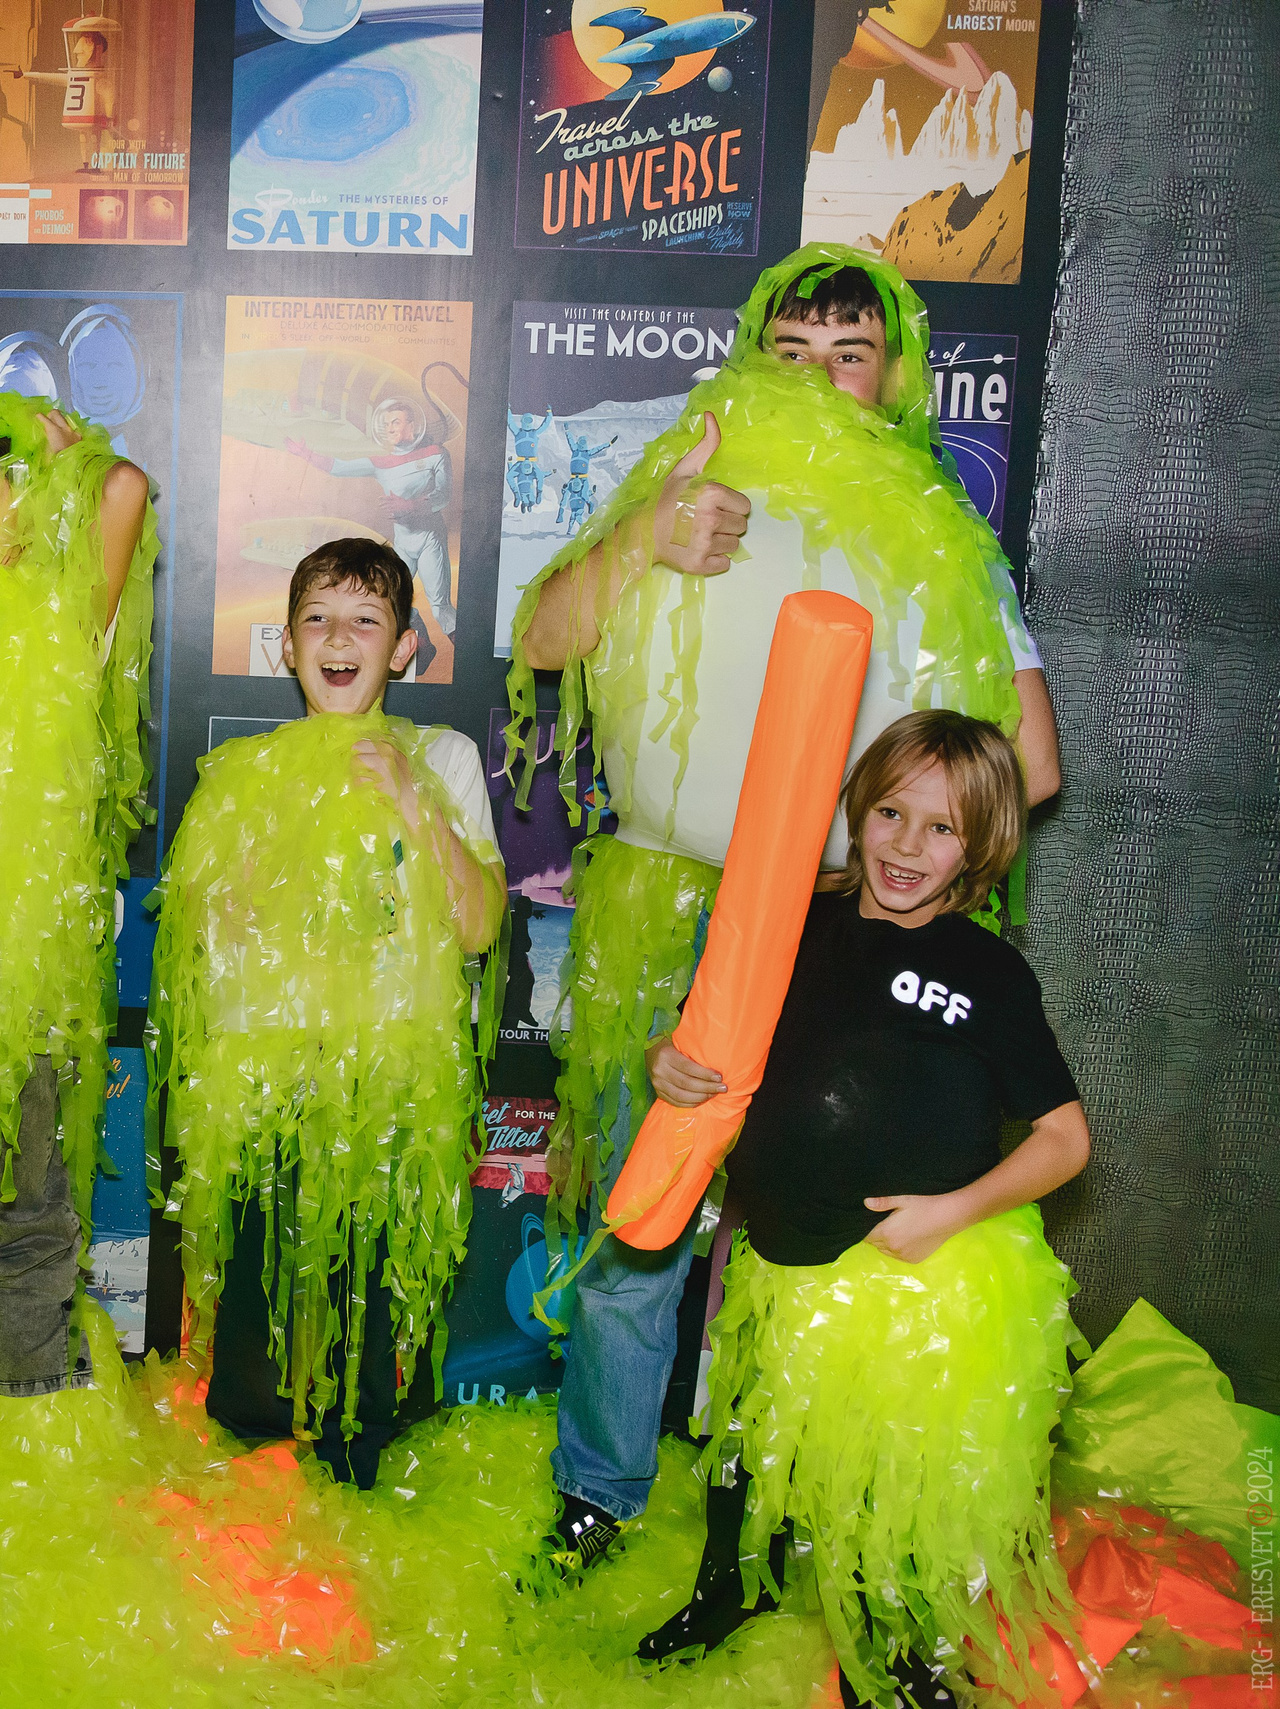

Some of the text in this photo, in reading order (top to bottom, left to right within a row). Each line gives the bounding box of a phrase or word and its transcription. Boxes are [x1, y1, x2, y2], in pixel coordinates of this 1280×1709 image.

[968, 0, 1017, 13] SATURN'S
[947, 14, 1035, 32] LARGEST MOON
[535, 90, 643, 154] Travel
[563, 112, 719, 161] across the
[91, 152, 185, 169] CAPTAIN FUTURE
[113, 172, 128, 182] MAN
[131, 172, 141, 183] OF
[144, 172, 184, 183] TOMORROW
[542, 129, 742, 235] UNIVERSE
[339, 194, 360, 203] THE
[365, 194, 427, 205] MYSTERIES
[433, 196, 449, 206] OF
[35, 209, 64, 221] PHOBOS
[641, 203, 723, 242] SPACESHIPS
[42, 223, 74, 235] DEIMOS!
[231, 208, 469, 249] SATURN
[244, 301, 455, 323] INTERPLANETARY TRAVEL
[564, 308, 695, 324] VISIT THE CRATERS OF THE
[280, 321, 418, 333] DELUXE ACCOMMODATIONS
[524, 322, 734, 361] THE MOON
[942, 342, 966, 367] of
[891, 970, 972, 1025] OFF
[500, 1029, 530, 1040] TOUR
[515, 1110, 535, 1119] FOR
[538, 1111, 556, 1120] THE
[487, 1125, 545, 1152] Tilted
